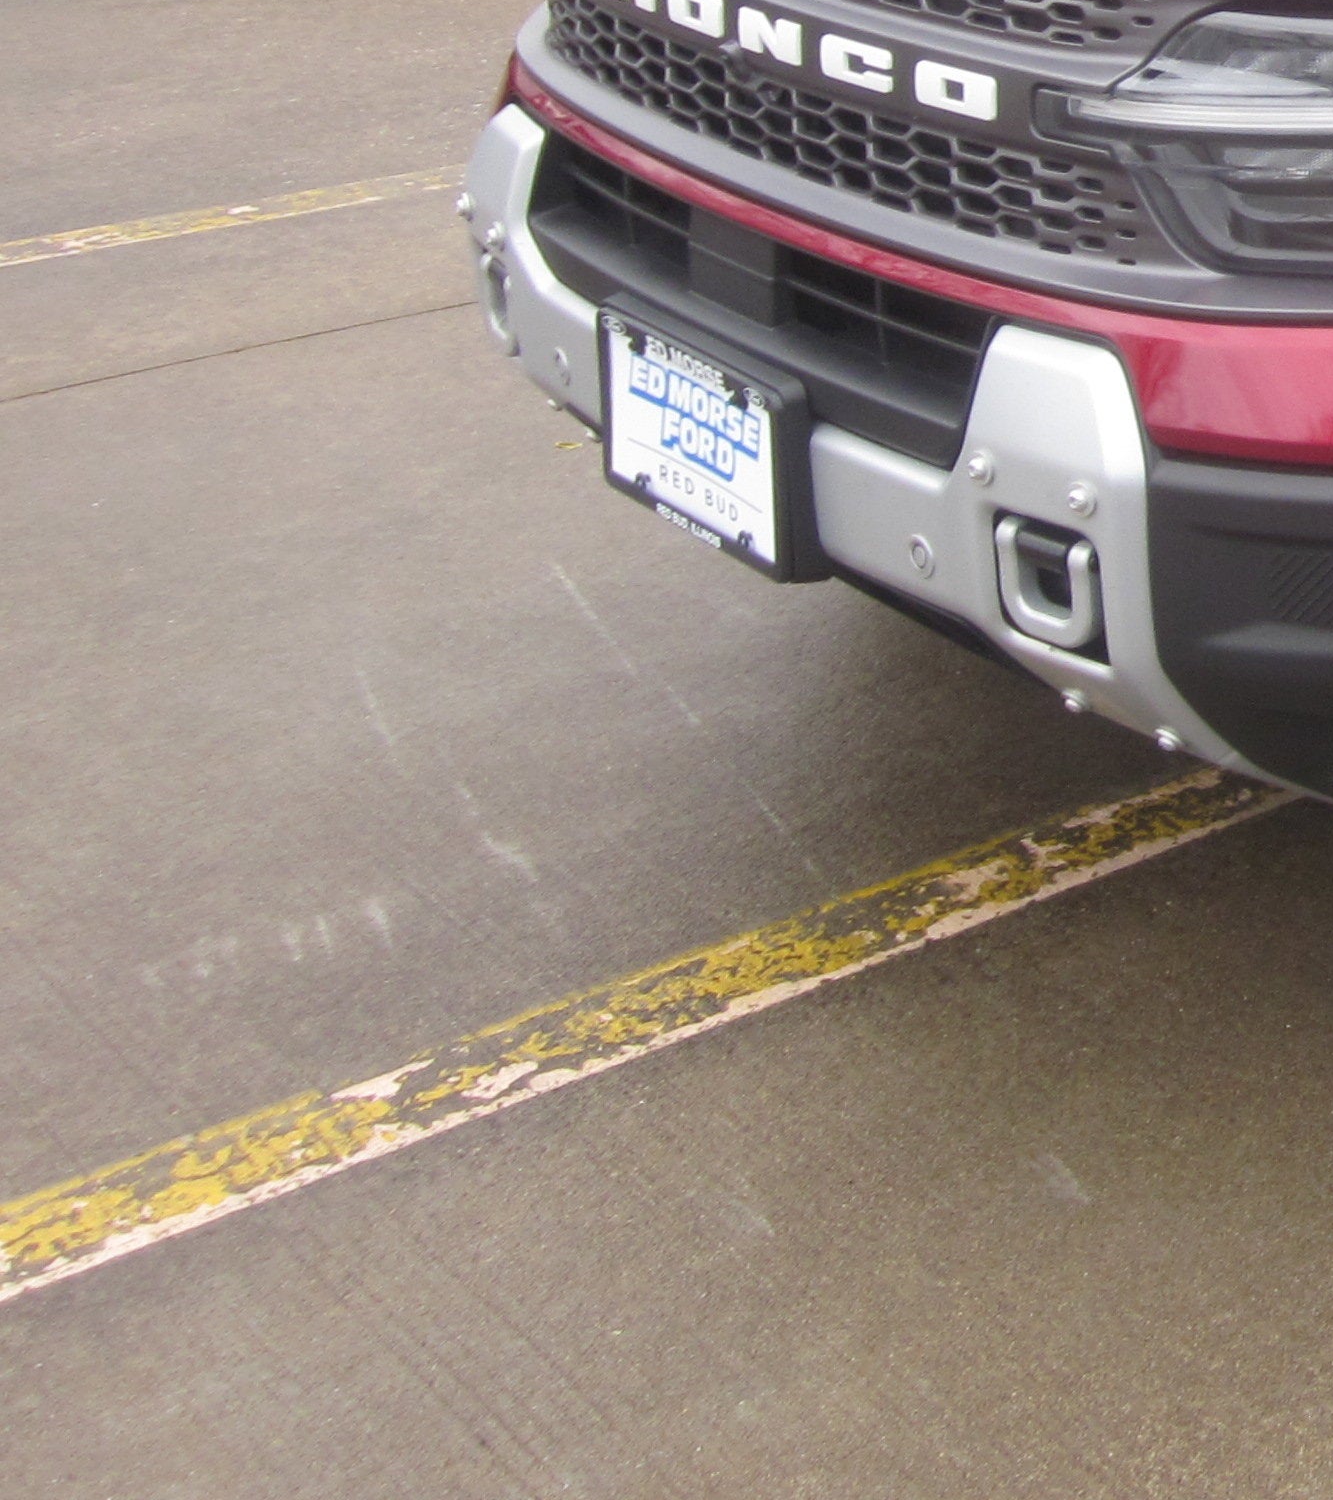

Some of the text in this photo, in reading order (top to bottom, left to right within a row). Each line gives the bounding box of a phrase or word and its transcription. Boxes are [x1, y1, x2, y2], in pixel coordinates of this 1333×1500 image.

[629, 354, 761, 462] ED MORSE
[661, 410, 736, 482] FORD
[659, 464, 739, 522] RED BUD
